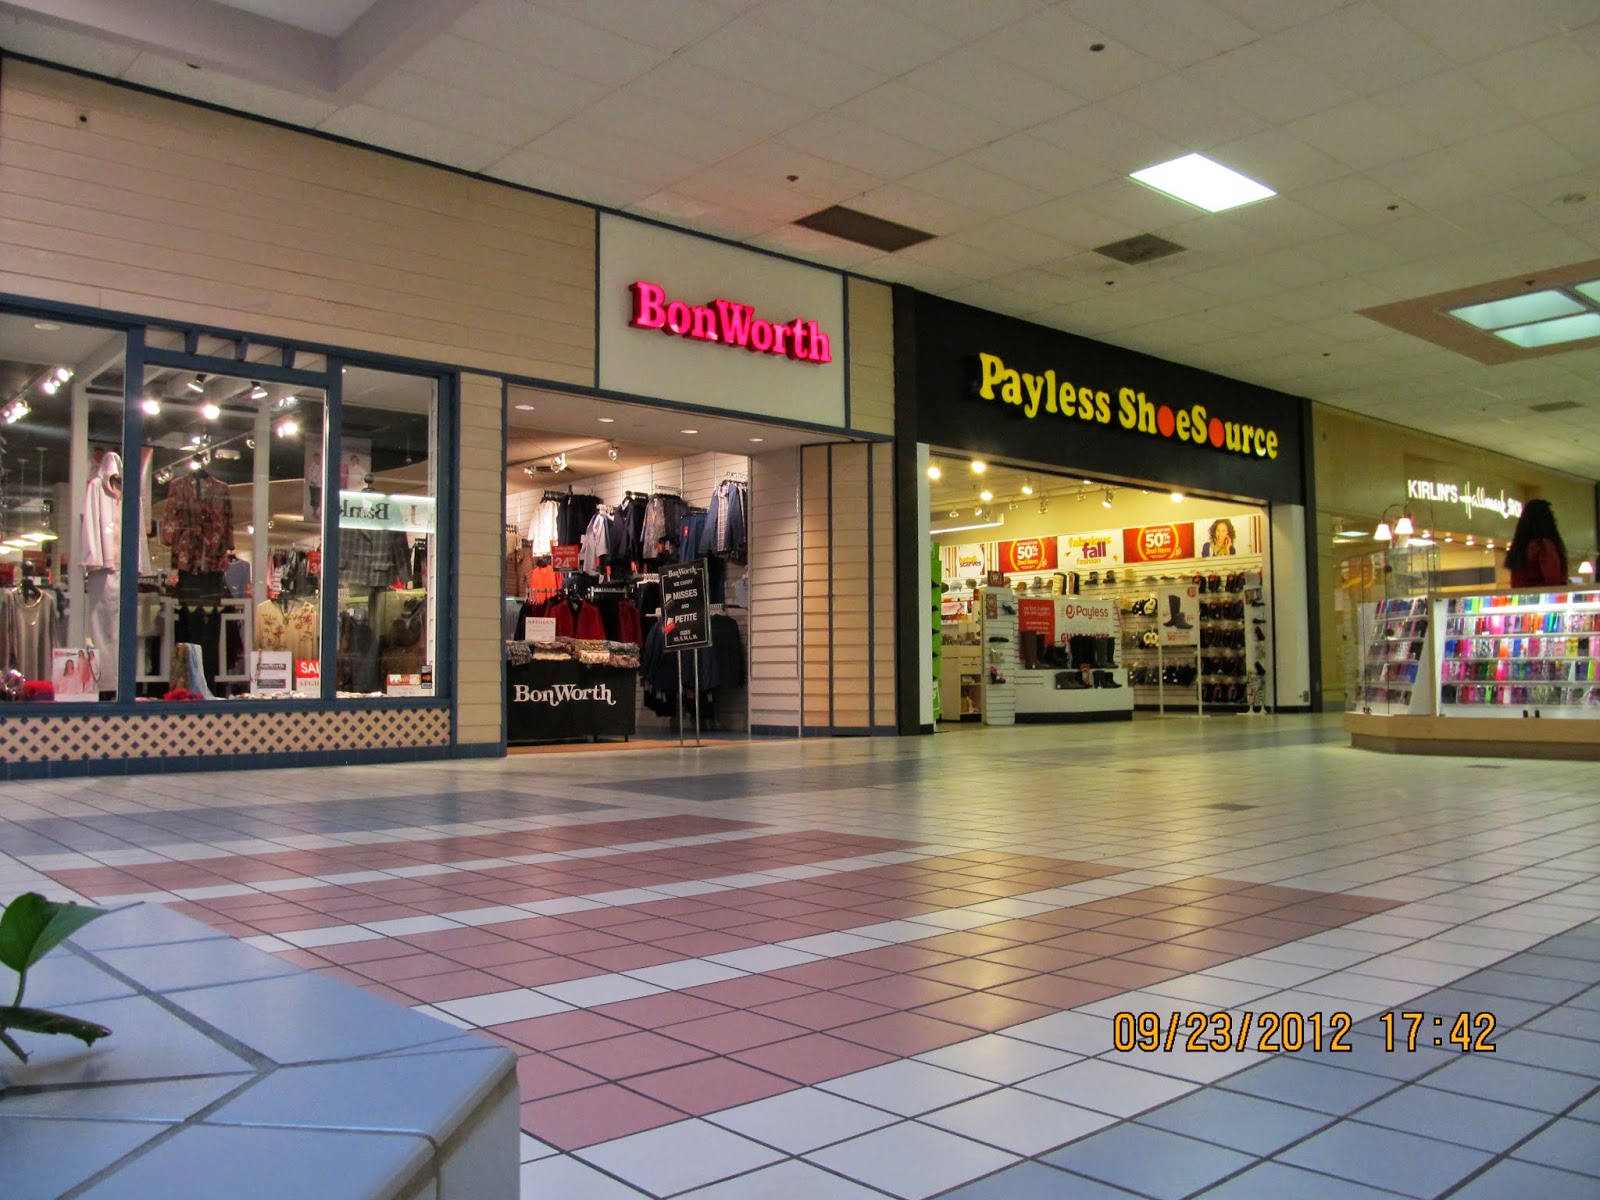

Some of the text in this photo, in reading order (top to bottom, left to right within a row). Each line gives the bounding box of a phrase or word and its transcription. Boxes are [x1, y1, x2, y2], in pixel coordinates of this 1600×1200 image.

[628, 281, 832, 363] BonWorth
[979, 352, 1279, 460] Payless ShoeSource
[1407, 479, 1459, 504] KIRLIN'S
[1459, 481, 1509, 520] Hallmark
[1082, 541, 1107, 559] fall
[668, 566, 697, 577] BonWorth
[673, 589, 697, 600] MISSES
[675, 613, 697, 623] PETITE
[1076, 605, 1109, 619] Payless
[513, 683, 617, 707] BonWorth
